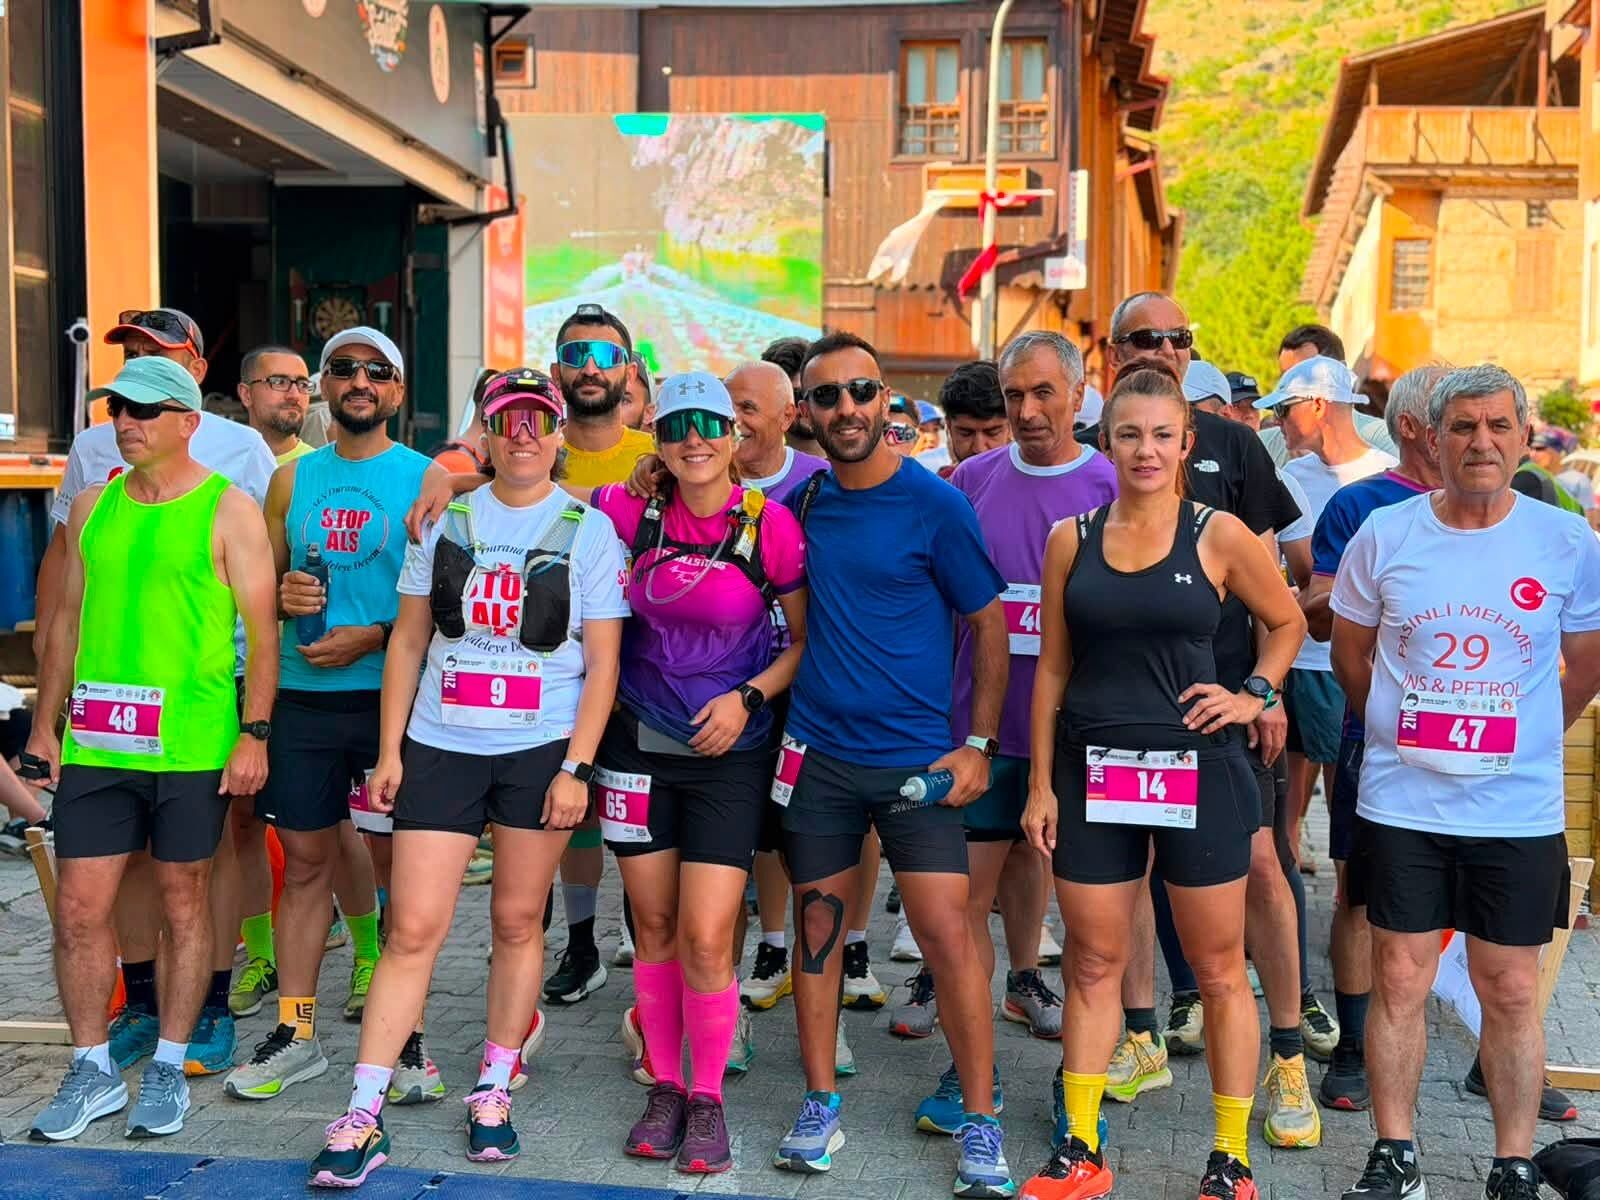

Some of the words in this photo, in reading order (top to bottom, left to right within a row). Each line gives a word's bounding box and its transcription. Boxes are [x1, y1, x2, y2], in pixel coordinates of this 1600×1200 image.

[320, 507, 371, 530] STOP
[325, 530, 359, 553] ALS
[1431, 632, 1490, 671] 29
[1459, 603, 1533, 669] MEHMET
[489, 676, 508, 707] 9
[1431, 678, 1446, 693] &
[107, 703, 138, 733] 48
[1447, 717, 1488, 751] 47
[1136, 770, 1168, 801] 14
[605, 790, 628, 821] 65
